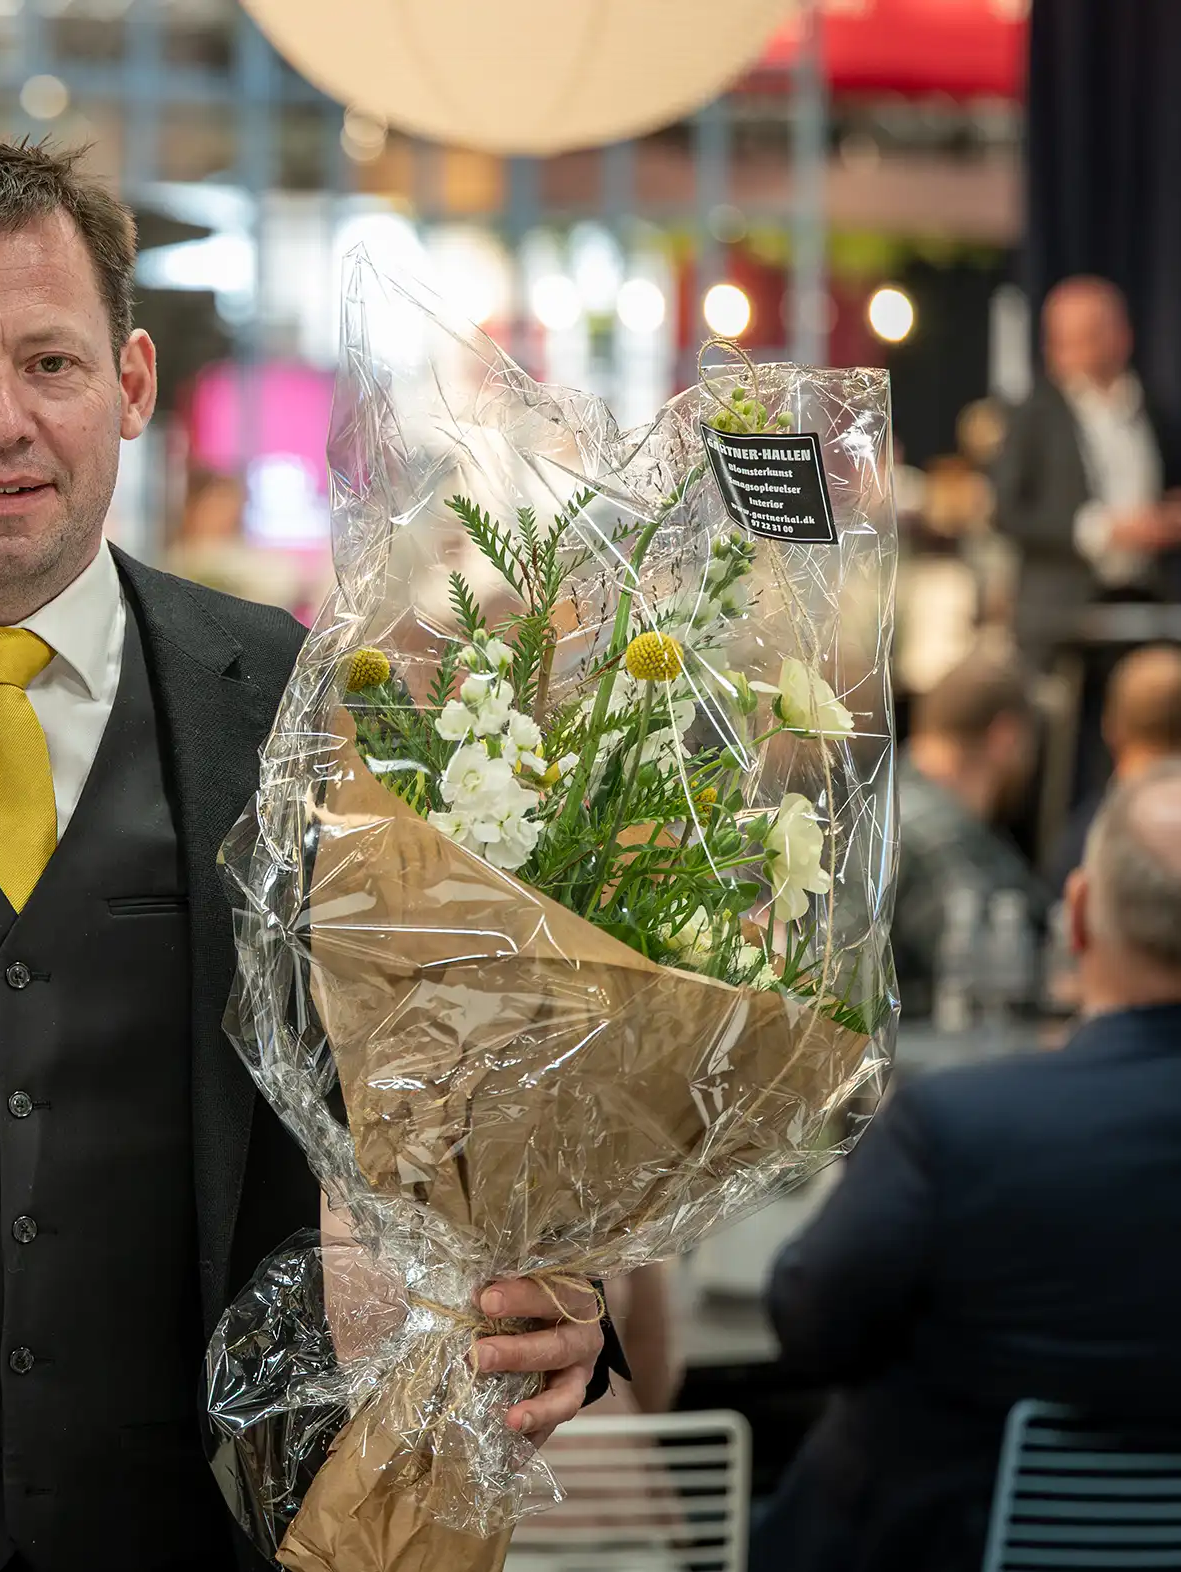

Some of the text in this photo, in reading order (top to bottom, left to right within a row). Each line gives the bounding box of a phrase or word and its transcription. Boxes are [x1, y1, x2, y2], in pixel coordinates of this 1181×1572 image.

[727, 462, 793, 478] Blomsterkunst
[731, 502, 815, 524] www.gartnerhal.dk
[761, 521, 771, 531] 22
[771, 524, 782, 532] 31
[782, 525, 794, 534] 00
